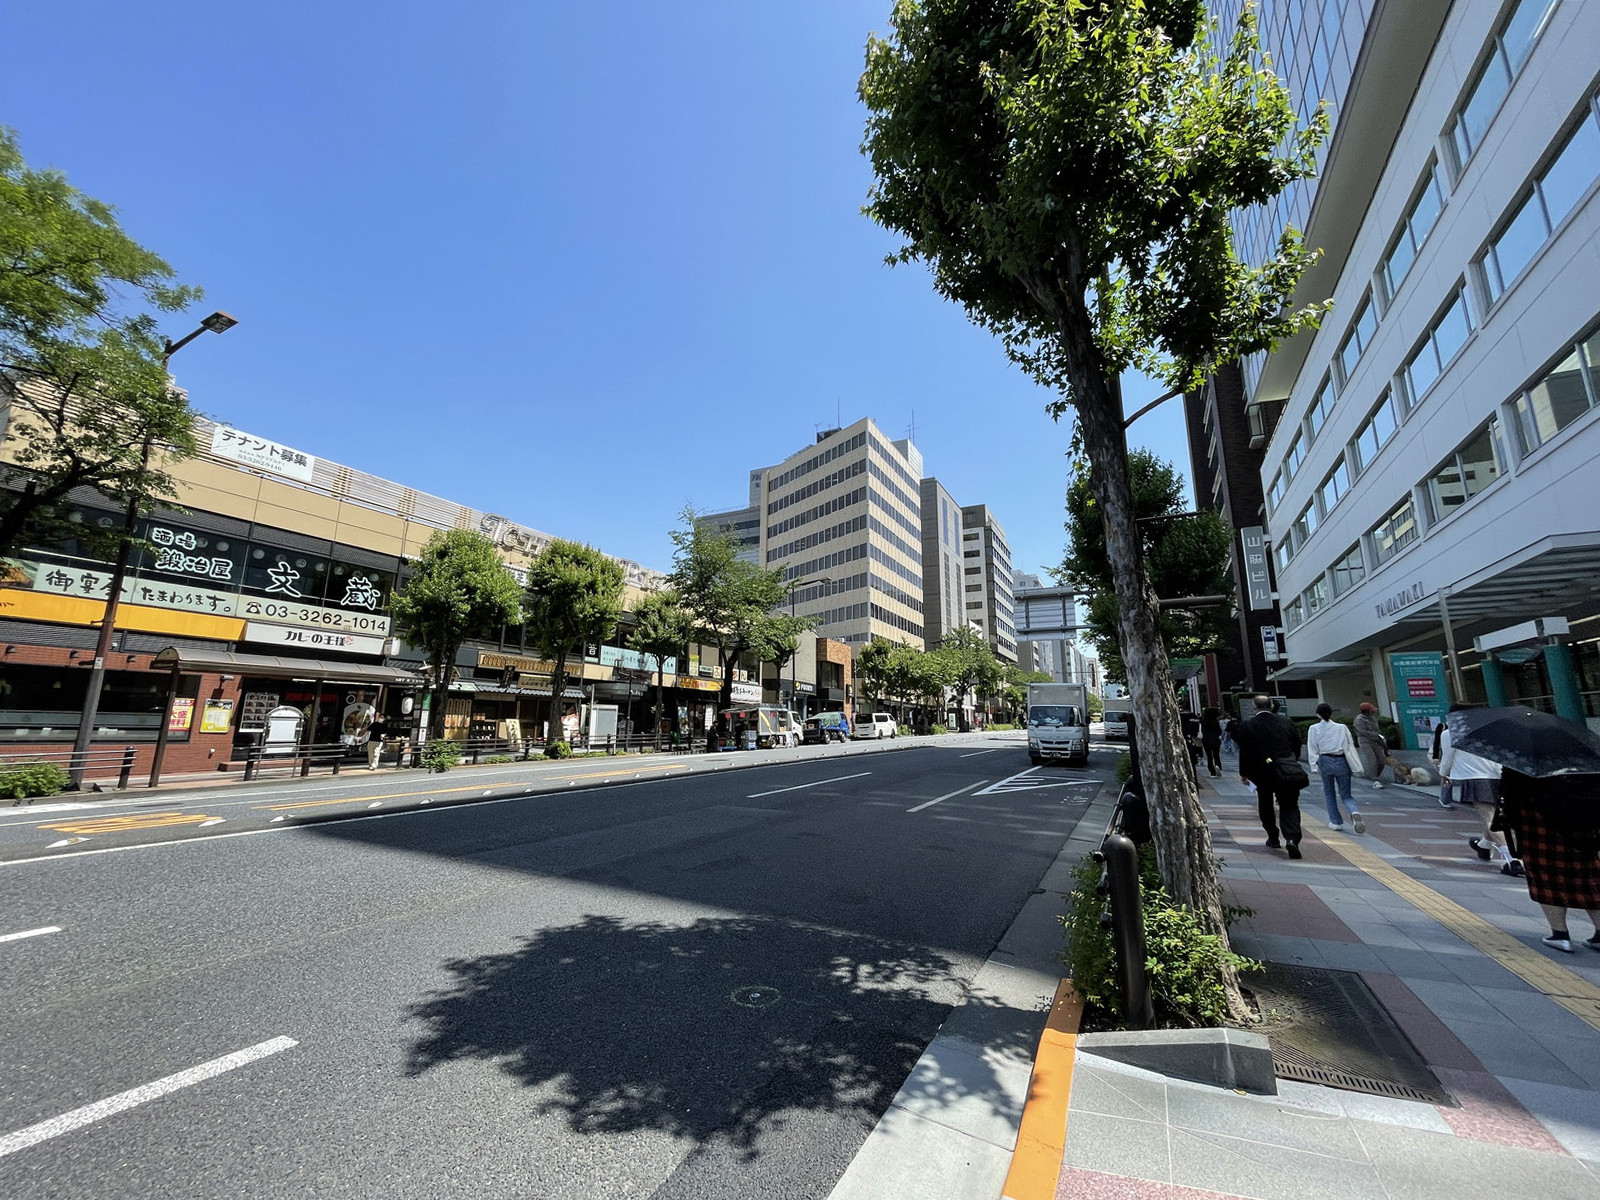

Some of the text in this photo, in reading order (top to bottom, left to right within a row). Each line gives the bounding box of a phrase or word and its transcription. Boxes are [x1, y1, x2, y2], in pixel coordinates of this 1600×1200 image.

[222, 430, 308, 467] テナント募集
[152, 527, 197, 550] 酒場
[155, 547, 233, 579] 鍛冶屋
[1247, 536, 1268, 600] 山脇ビル
[141, 586, 231, 613] たまわります。
[265, 603, 387, 632] 03-3262-1014
[284, 631, 346, 646] カレーの王様
